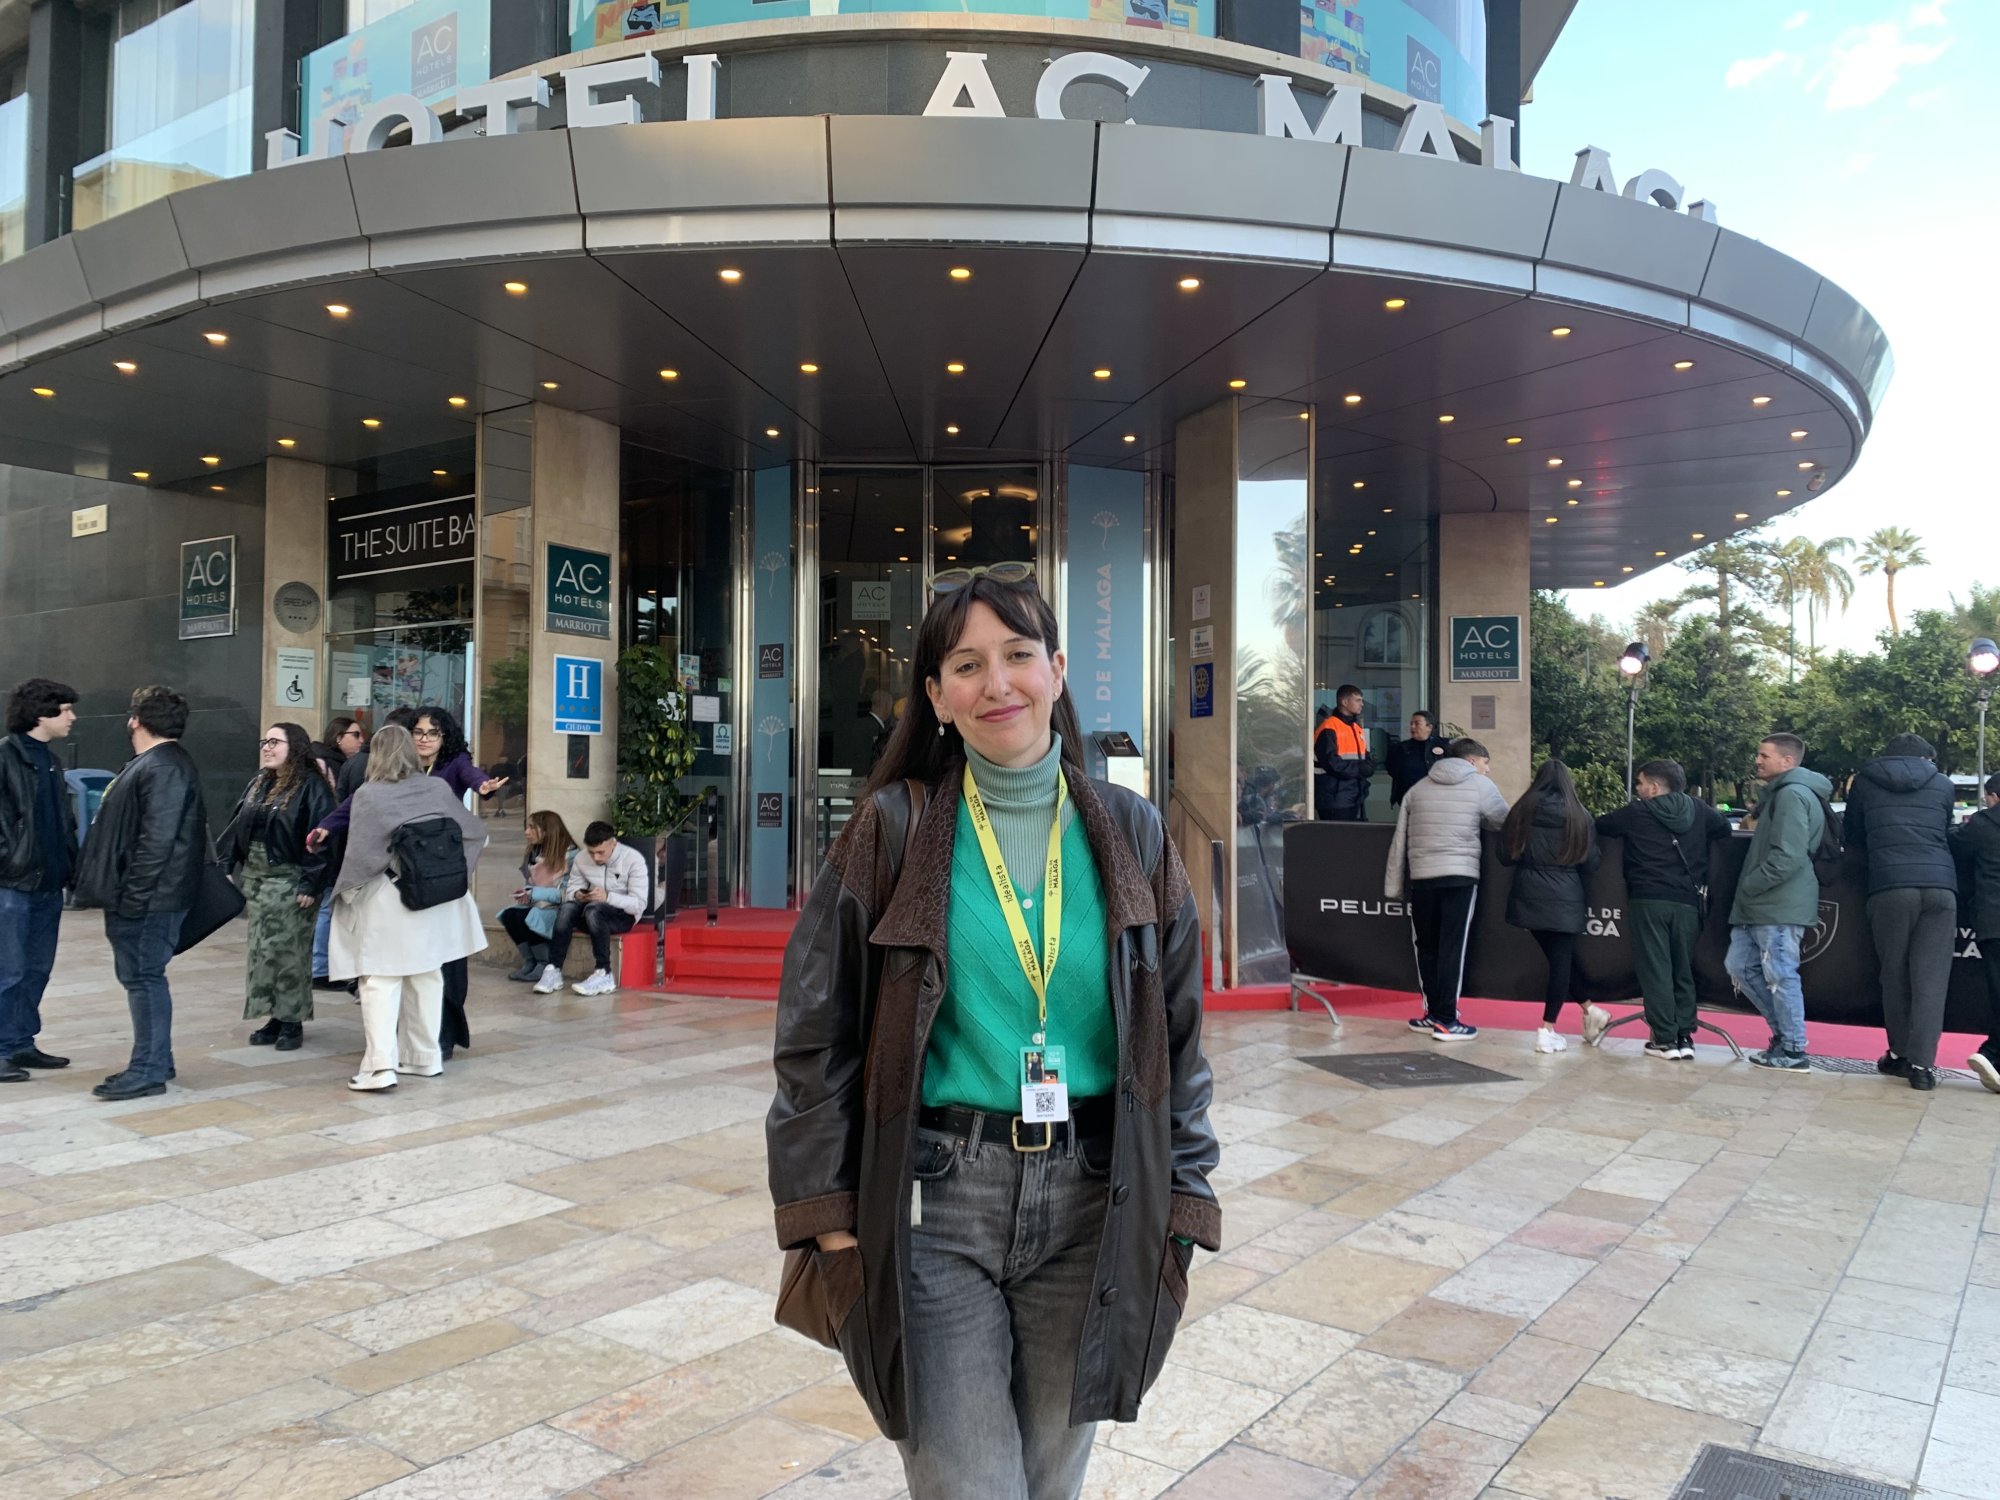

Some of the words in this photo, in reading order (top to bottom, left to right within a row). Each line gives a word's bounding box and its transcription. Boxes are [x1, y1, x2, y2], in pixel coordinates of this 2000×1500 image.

[417, 25, 452, 64] AC
[1411, 51, 1438, 88] AC
[922, 51, 1151, 125] AC
[340, 528, 382, 561] THE
[385, 517, 444, 555] SUITE
[449, 513, 475, 546] BA
[187, 551, 226, 589] AC
[555, 560, 602, 594] AC
[186, 591, 226, 605] HOTELS
[554, 593, 603, 609] HOTELS
[857, 586, 886, 601] AC
[186, 619, 225, 634] MARRIOTT
[555, 618, 602, 633] MARRIOTT
[1461, 625, 1510, 648] AC
[762, 648, 782, 662] AC
[1460, 651, 1511, 660] HOTELS
[566, 664, 591, 699] H
[1461, 670, 1511, 678] MARRIOTT
[1096, 670, 1112, 701] DE
[565, 722, 591, 731] CIUDAD
[760, 797, 780, 811] AC
[996, 864, 1014, 903] idealista
[1320, 899, 1412, 916] PEUG
[1601, 907, 1621, 919] DE
